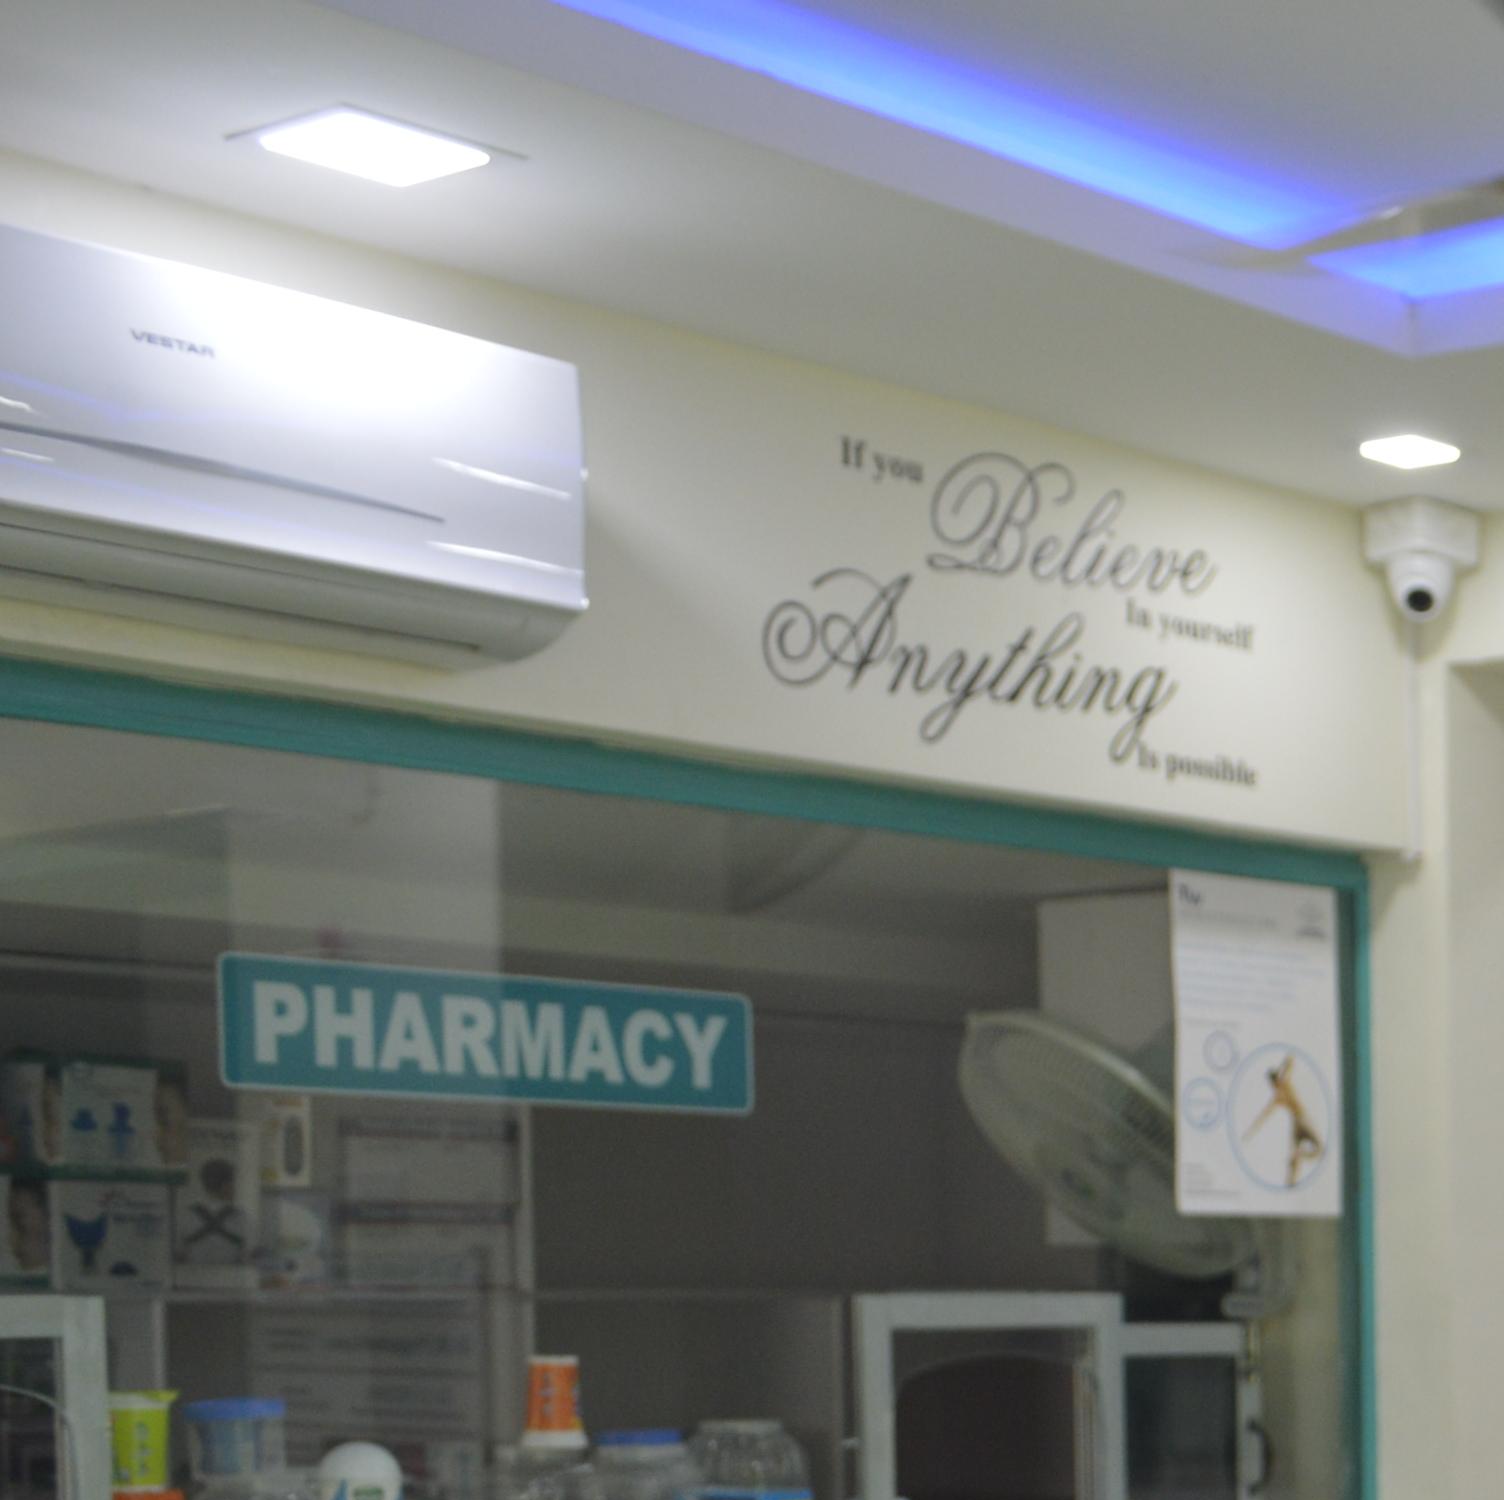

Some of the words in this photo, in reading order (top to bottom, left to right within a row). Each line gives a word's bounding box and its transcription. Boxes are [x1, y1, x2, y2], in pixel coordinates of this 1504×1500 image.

[130, 327, 216, 359] VESTAR
[839, 436, 866, 470] If
[872, 446, 923, 485] you
[927, 451, 1215, 596] Believe
[1158, 610, 1254, 652] yourself
[761, 567, 1177, 764] Anything
[1165, 754, 1257, 789] possible
[252, 980, 728, 1092] PHARMACY
